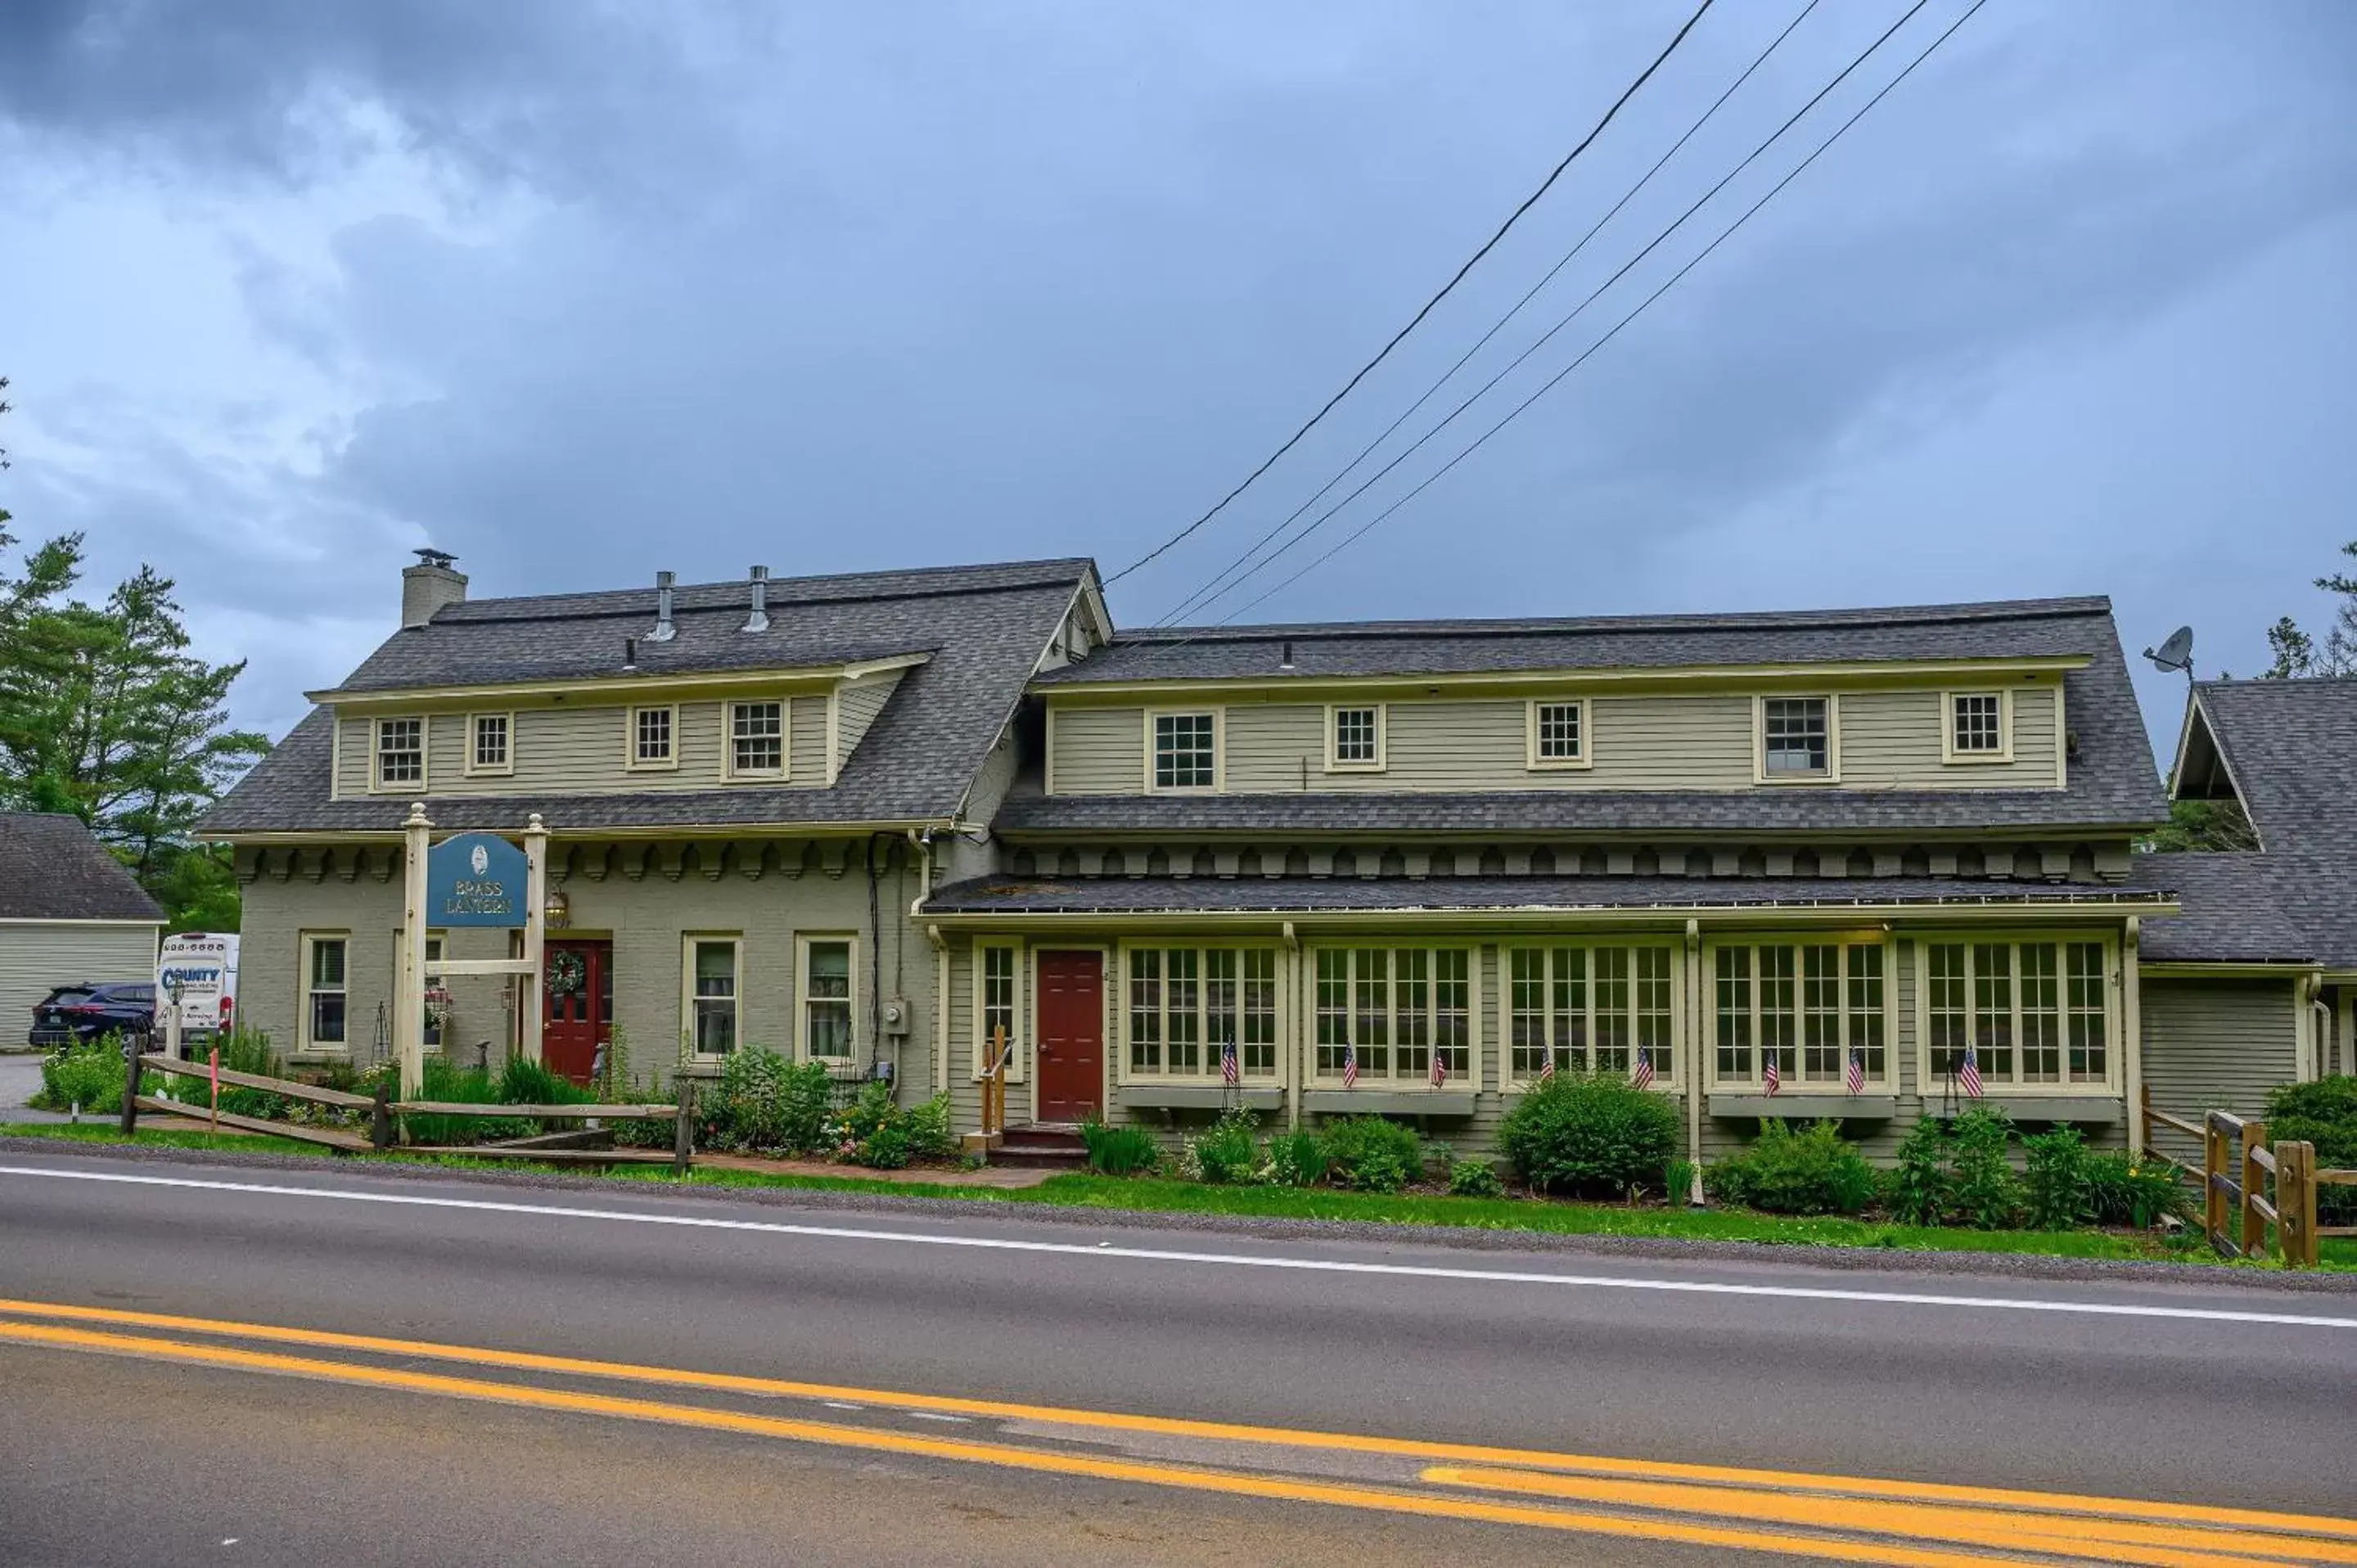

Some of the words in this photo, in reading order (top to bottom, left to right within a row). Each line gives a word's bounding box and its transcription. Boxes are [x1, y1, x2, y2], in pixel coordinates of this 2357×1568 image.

[456, 881, 503, 896] BRASS
[446, 898, 511, 913] LANTERN
[162, 968, 220, 989] COUNTY
